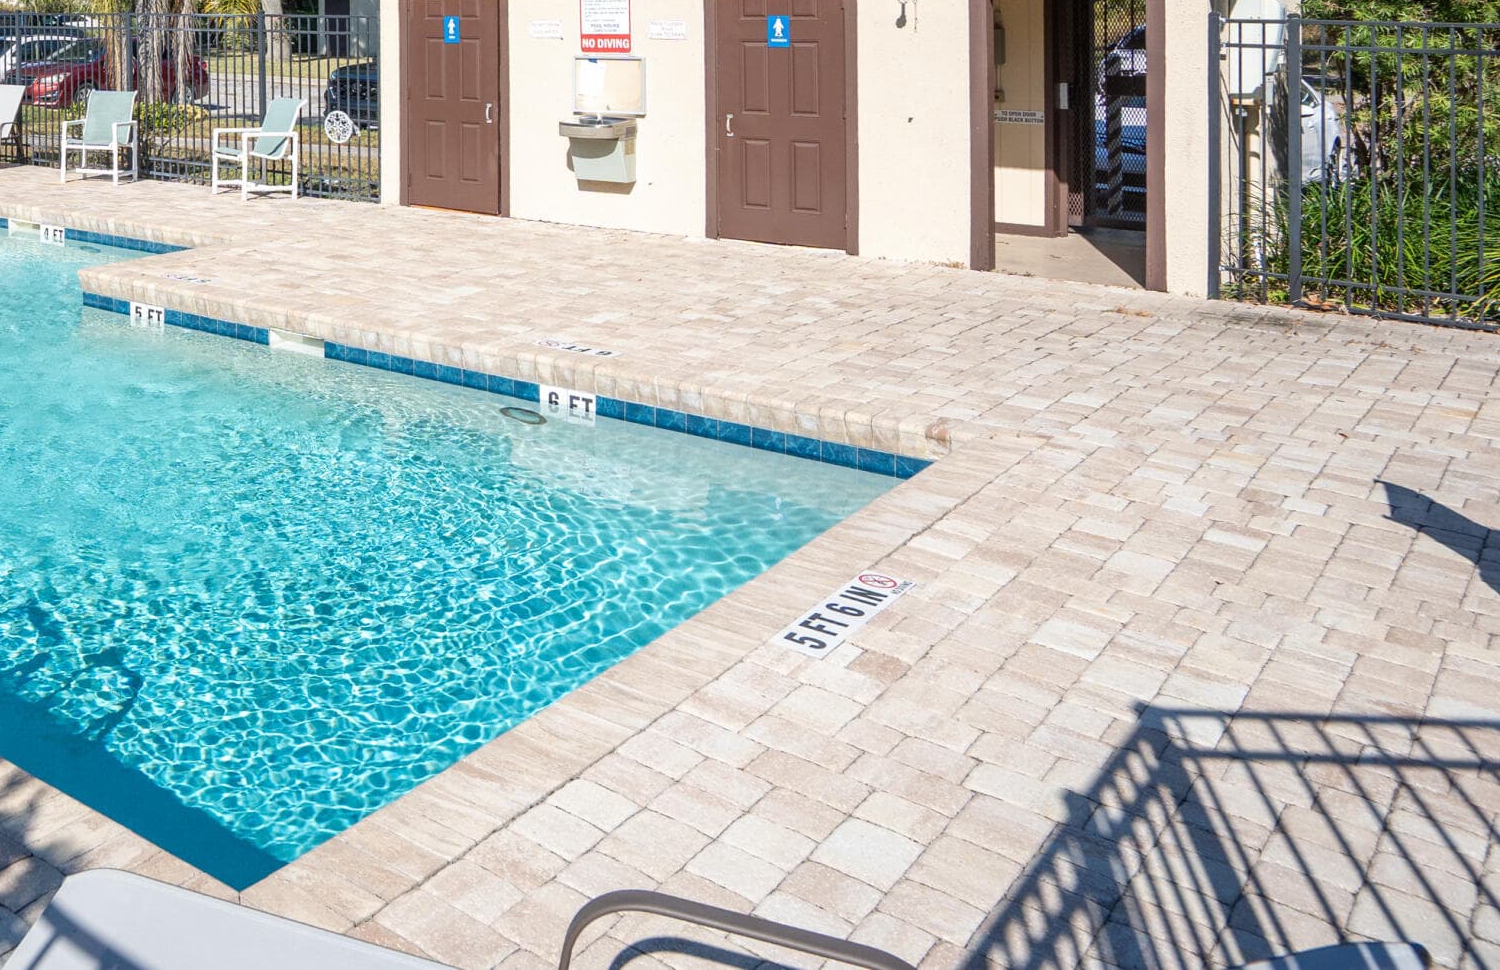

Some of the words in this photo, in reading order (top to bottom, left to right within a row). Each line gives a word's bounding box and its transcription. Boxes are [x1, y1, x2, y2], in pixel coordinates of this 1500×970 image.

[582, 38, 596, 48] NO
[597, 38, 629, 48] DIVING
[135, 305, 142, 318] 5
[147, 308, 162, 322] FT
[548, 391, 559, 406] 6
[569, 394, 593, 413] FT
[839, 585, 889, 607] IN
[825, 603, 866, 617] 6
[798, 612, 849, 637] FT
[783, 631, 827, 650] 5
